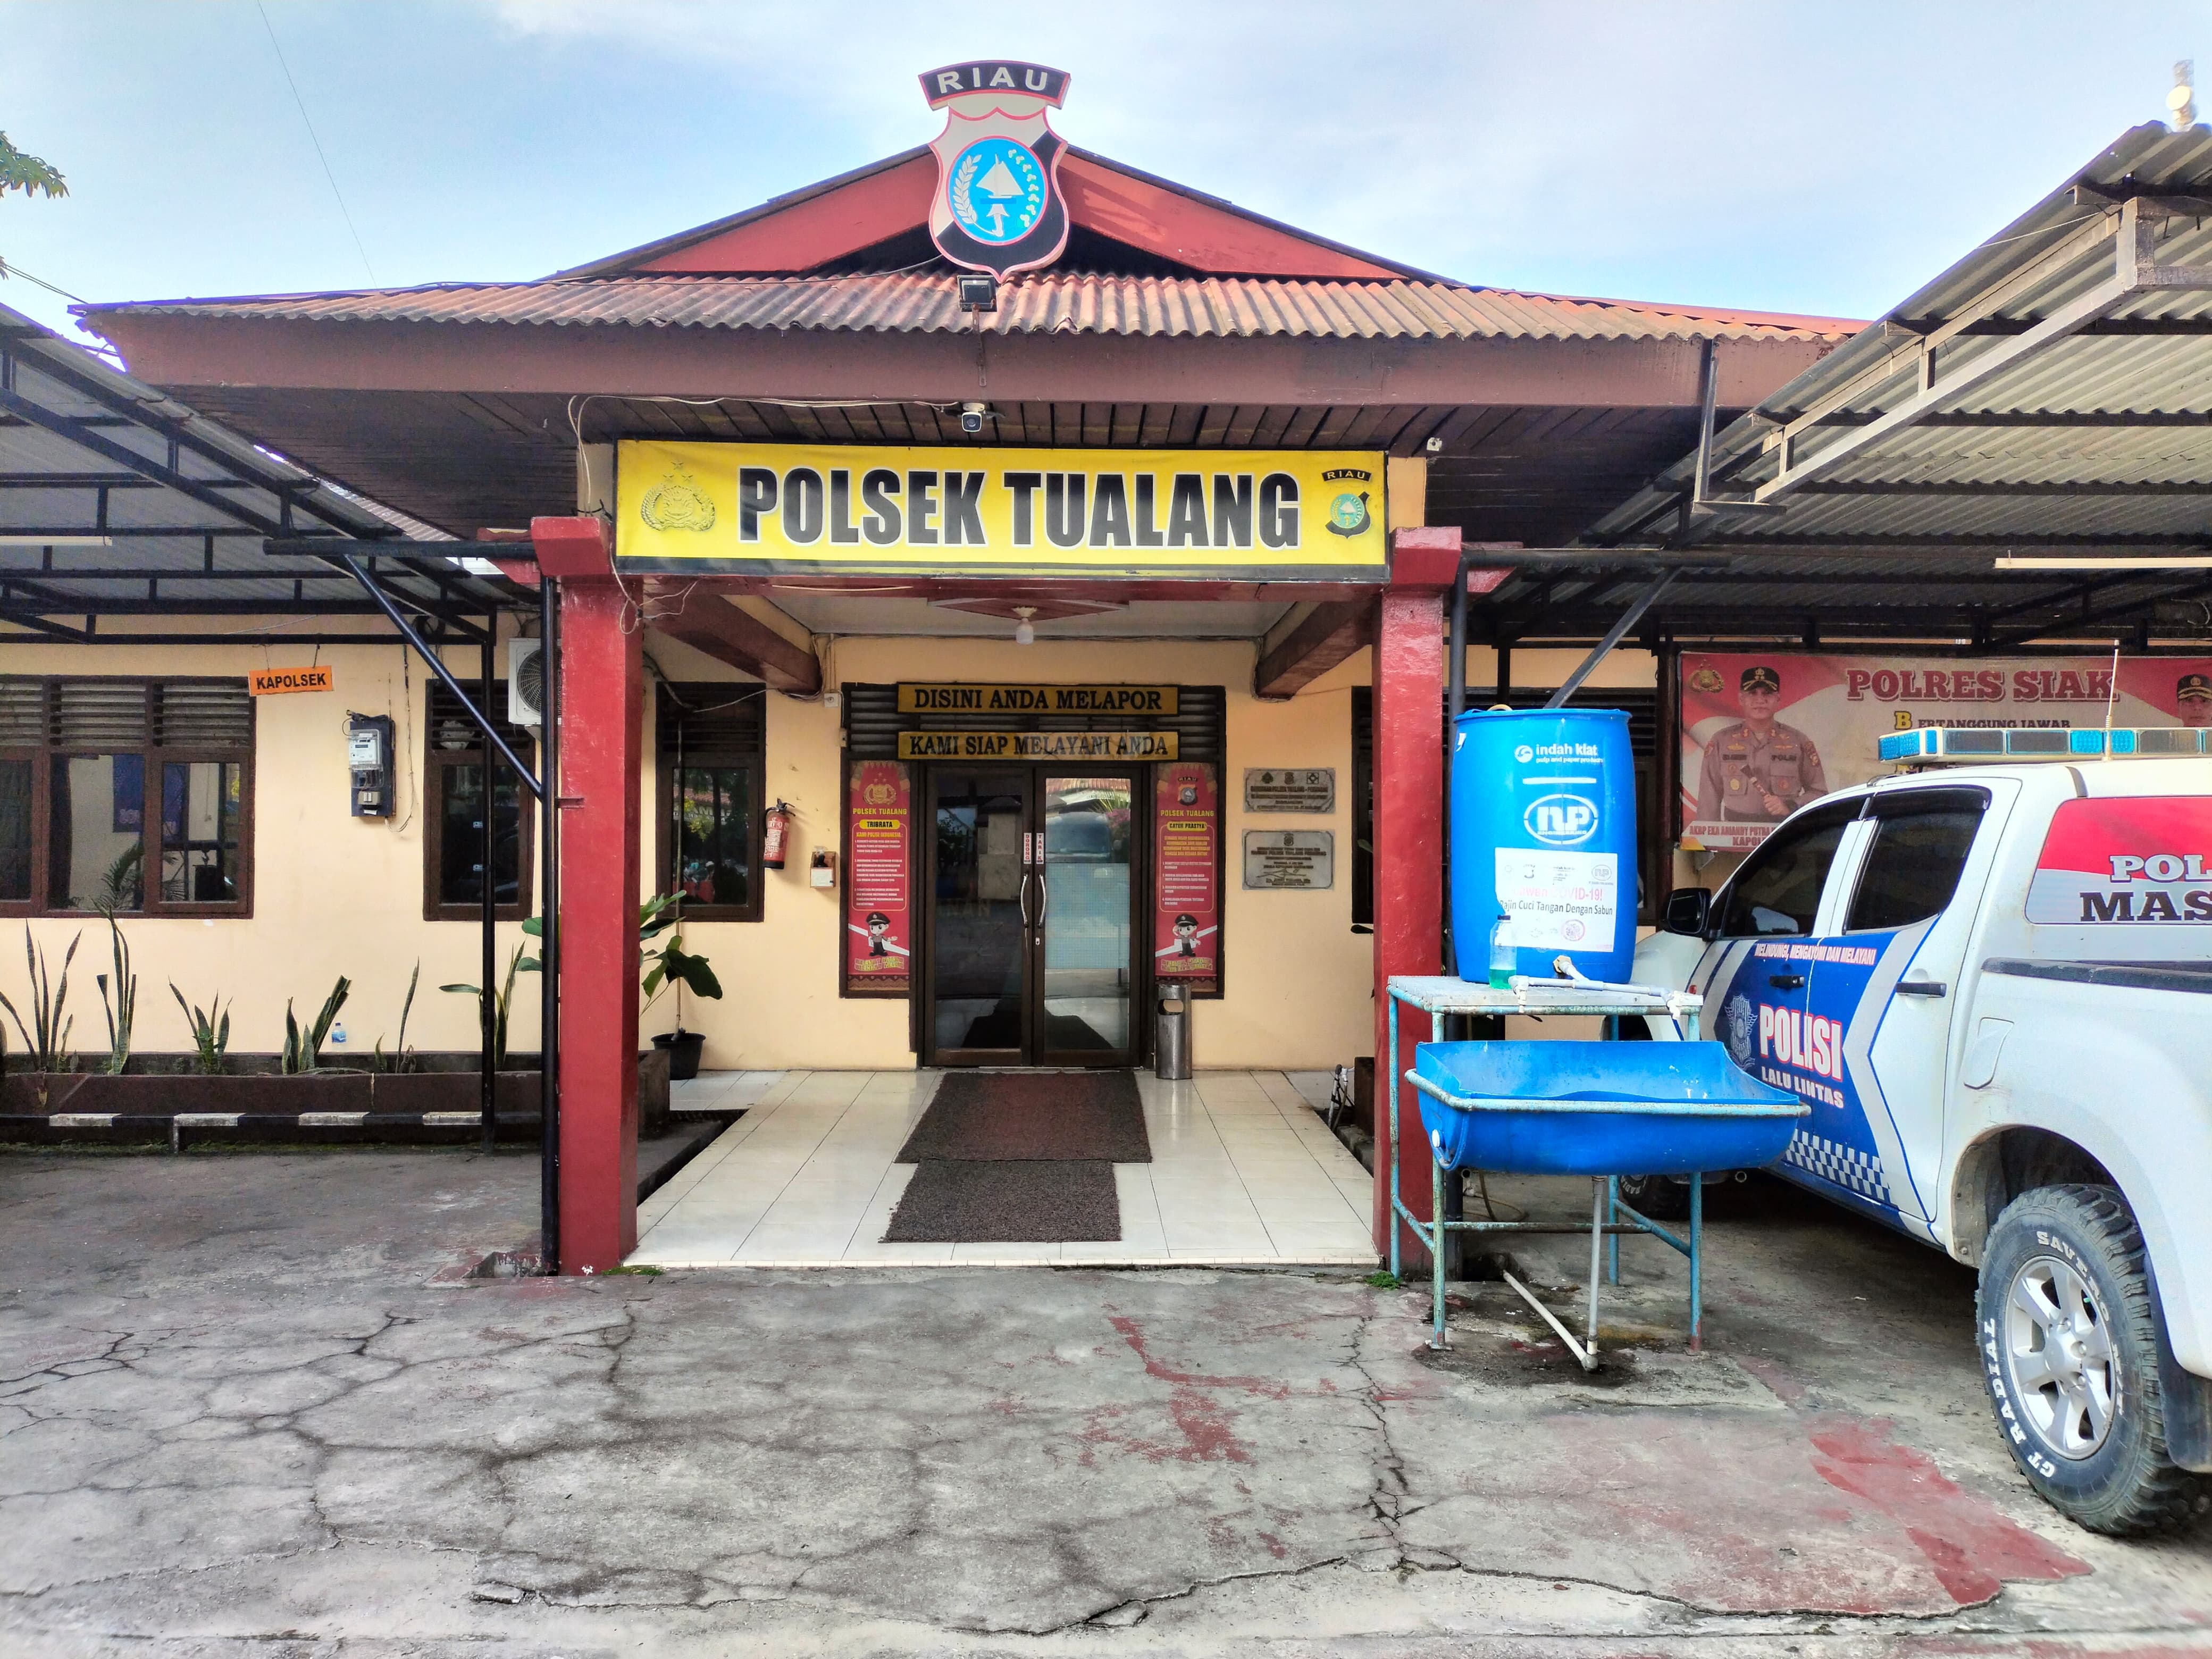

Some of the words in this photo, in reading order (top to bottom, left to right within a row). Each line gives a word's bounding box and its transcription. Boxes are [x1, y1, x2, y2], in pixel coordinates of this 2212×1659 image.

[937, 67, 1048, 94] RIAU
[1327, 471, 1365, 479] RIAU
[739, 467, 987, 547] POLSEK
[1003, 471, 1301, 549] TUALANG
[256, 673, 326, 690] KAPOLSEK
[1846, 669, 2005, 702] POLRES
[2013, 670, 2120, 702] SIAK
[914, 689, 982, 708] DISINI
[990, 689, 1049, 709] ANDA
[1055, 690, 1162, 710] MELAPOR
[910, 736, 959, 755] KAMI
[965, 736, 1008, 756] SIAP
[1013, 735, 1110, 755] MELAYANI
[1117, 736, 1168, 755] ANDA
[1536, 743, 1572, 755] indah
[1519, 900, 1534, 909] Cuci
[1537, 901, 1563, 914] Tangan
[1566, 903, 1593, 916] Dengan
[1594, 904, 1613, 915] Sabun
[1826, 946, 1842, 962] DAN
[1840, 947, 1877, 965] MELAYANI
[1759, 1004, 1843, 1082] POLISI
[1761, 1066, 1791, 1089] LALU
[1794, 1075, 1844, 1109] LINTAS
[1984, 1318, 2027, 1445] RADIAL
[2027, 1452, 2055, 1478] GT
